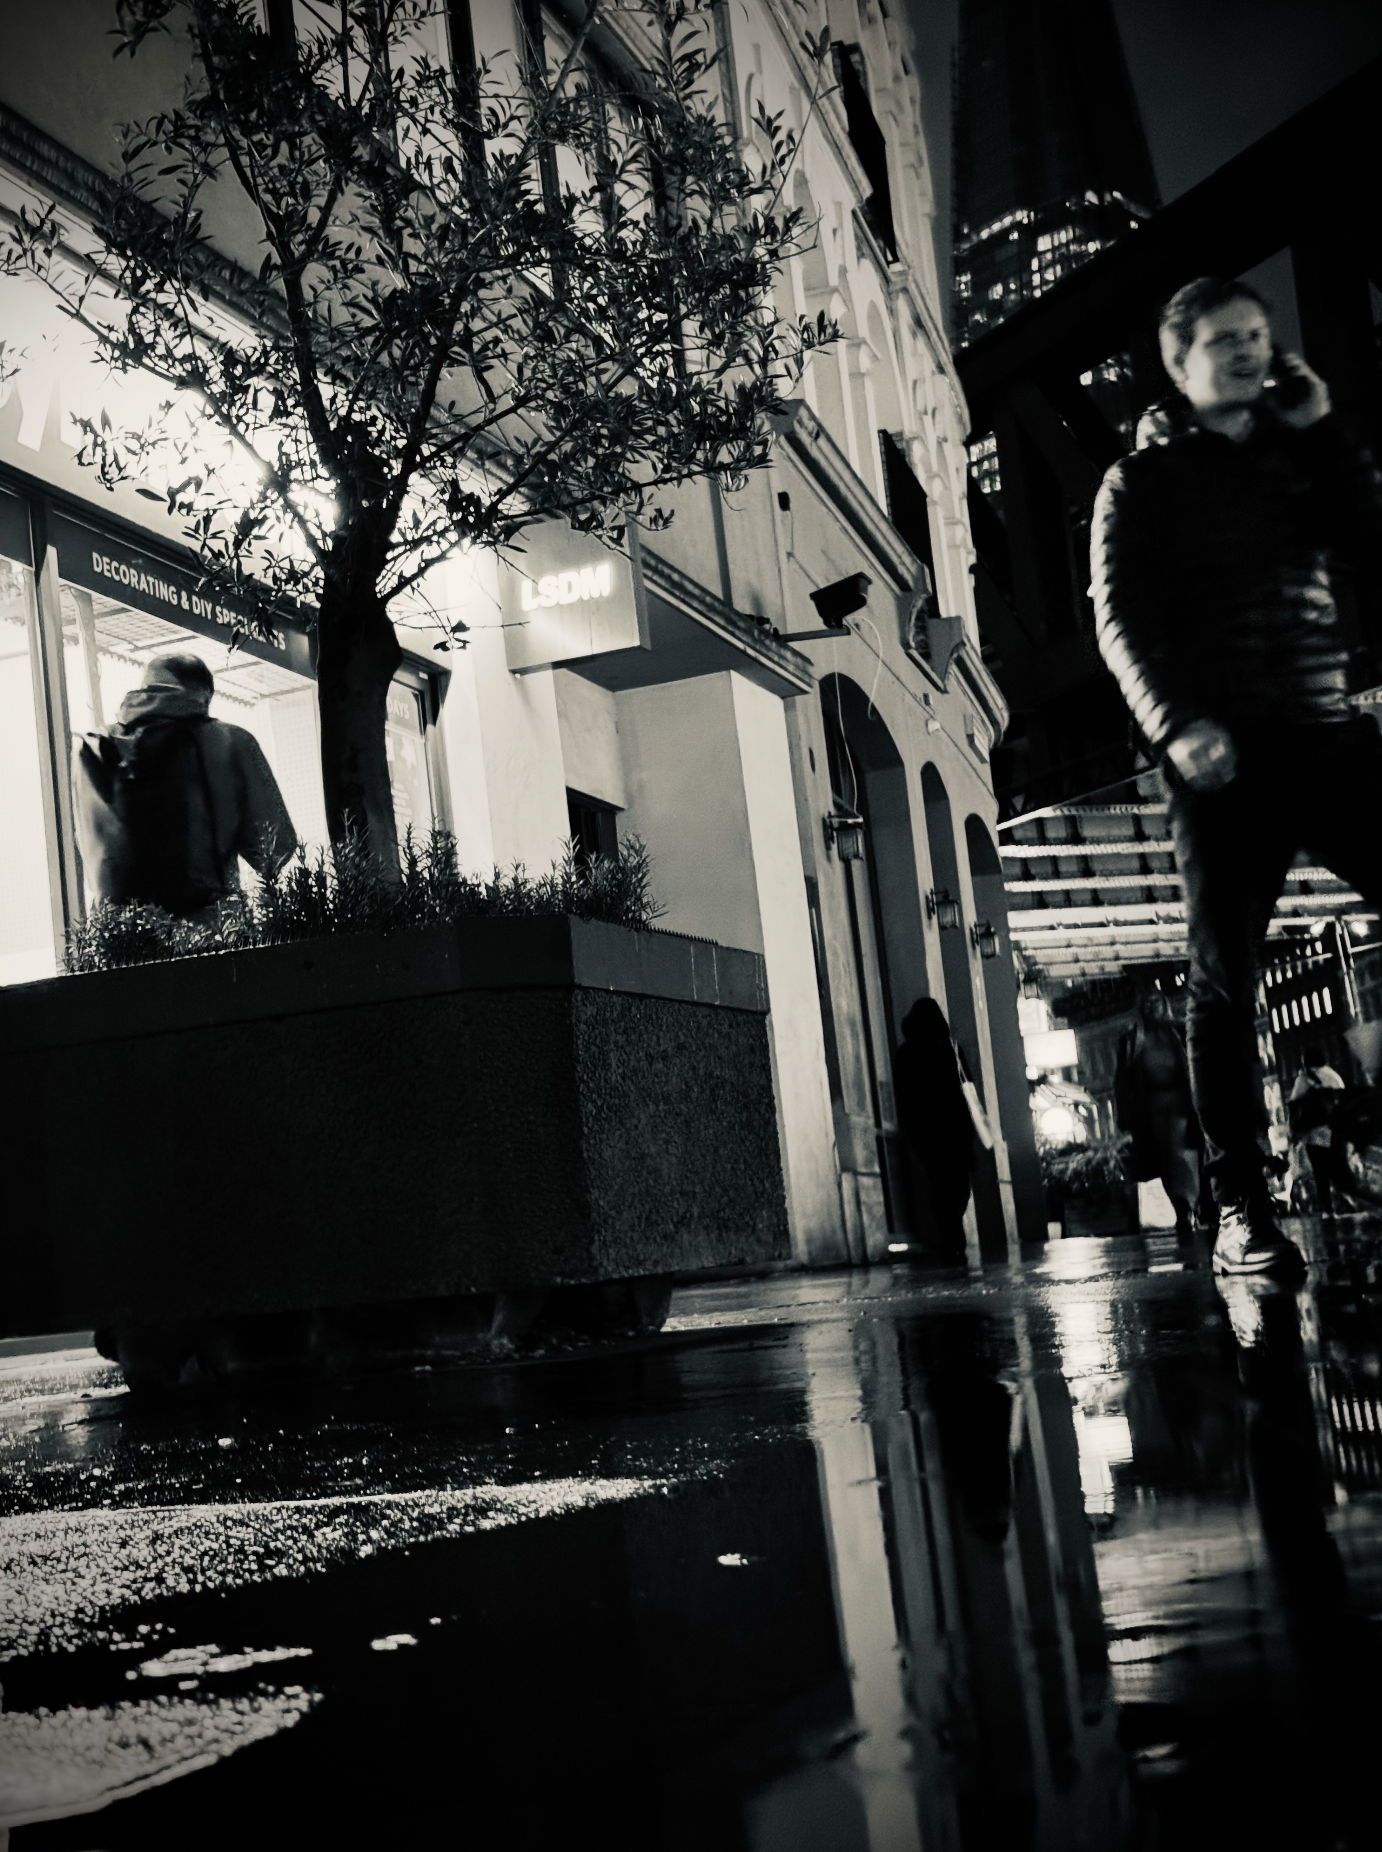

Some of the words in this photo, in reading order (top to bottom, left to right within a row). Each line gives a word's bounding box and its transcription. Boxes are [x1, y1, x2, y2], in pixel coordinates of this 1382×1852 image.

[92, 552, 178, 606] DECORATING
[181, 590, 190, 611] &
[191, 595, 213, 620] DIY
[521, 564, 611, 612] LSDM
